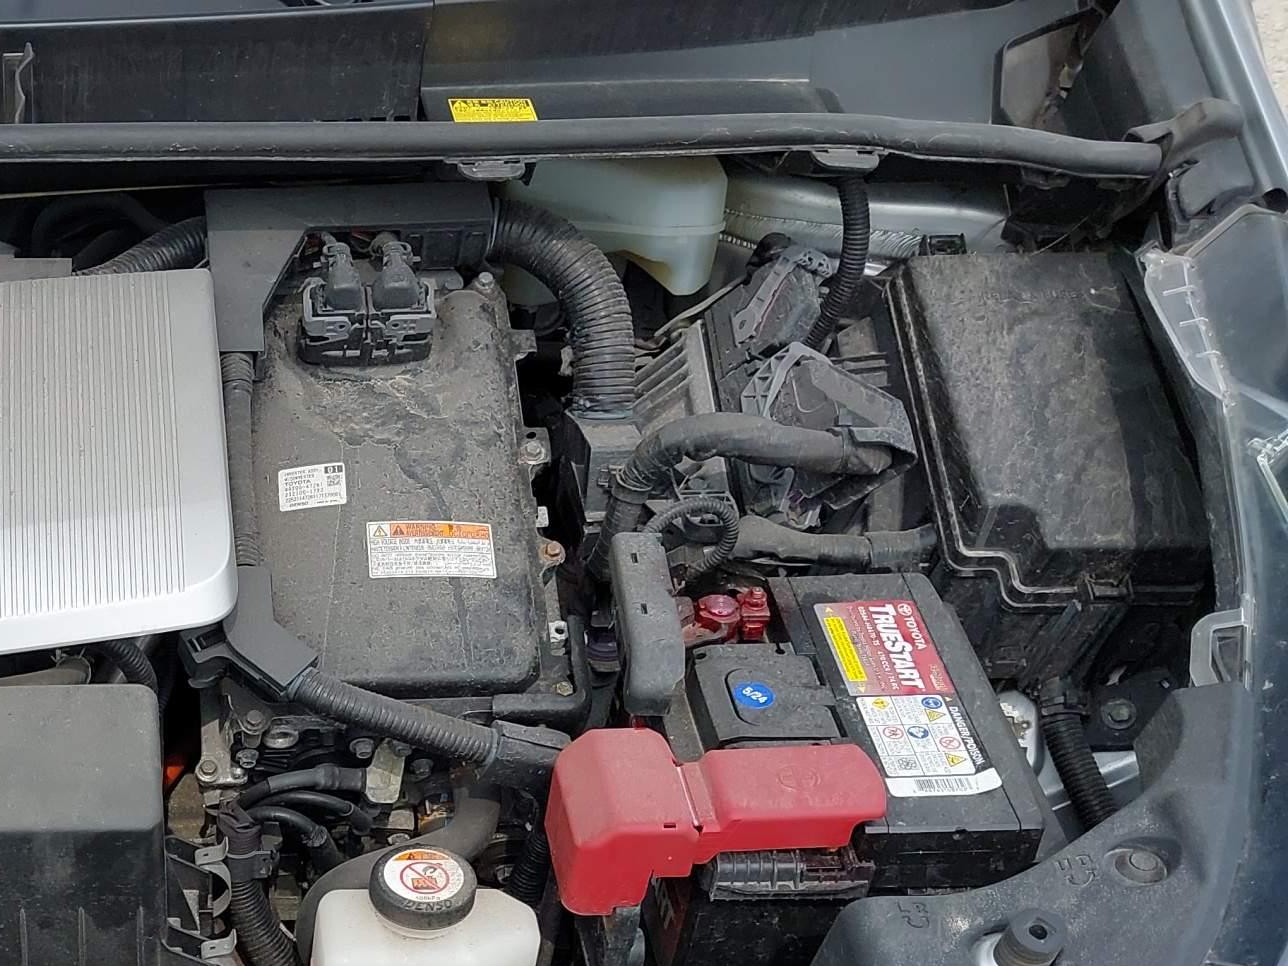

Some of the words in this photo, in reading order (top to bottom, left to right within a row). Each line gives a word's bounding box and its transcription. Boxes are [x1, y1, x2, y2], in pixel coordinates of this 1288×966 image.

[327, 465, 339, 474] 01
[904, 615, 927, 650] TOYOTA
[742, 686, 768, 704] 5/24
[948, 706, 986, 766] DANGER/POISON
